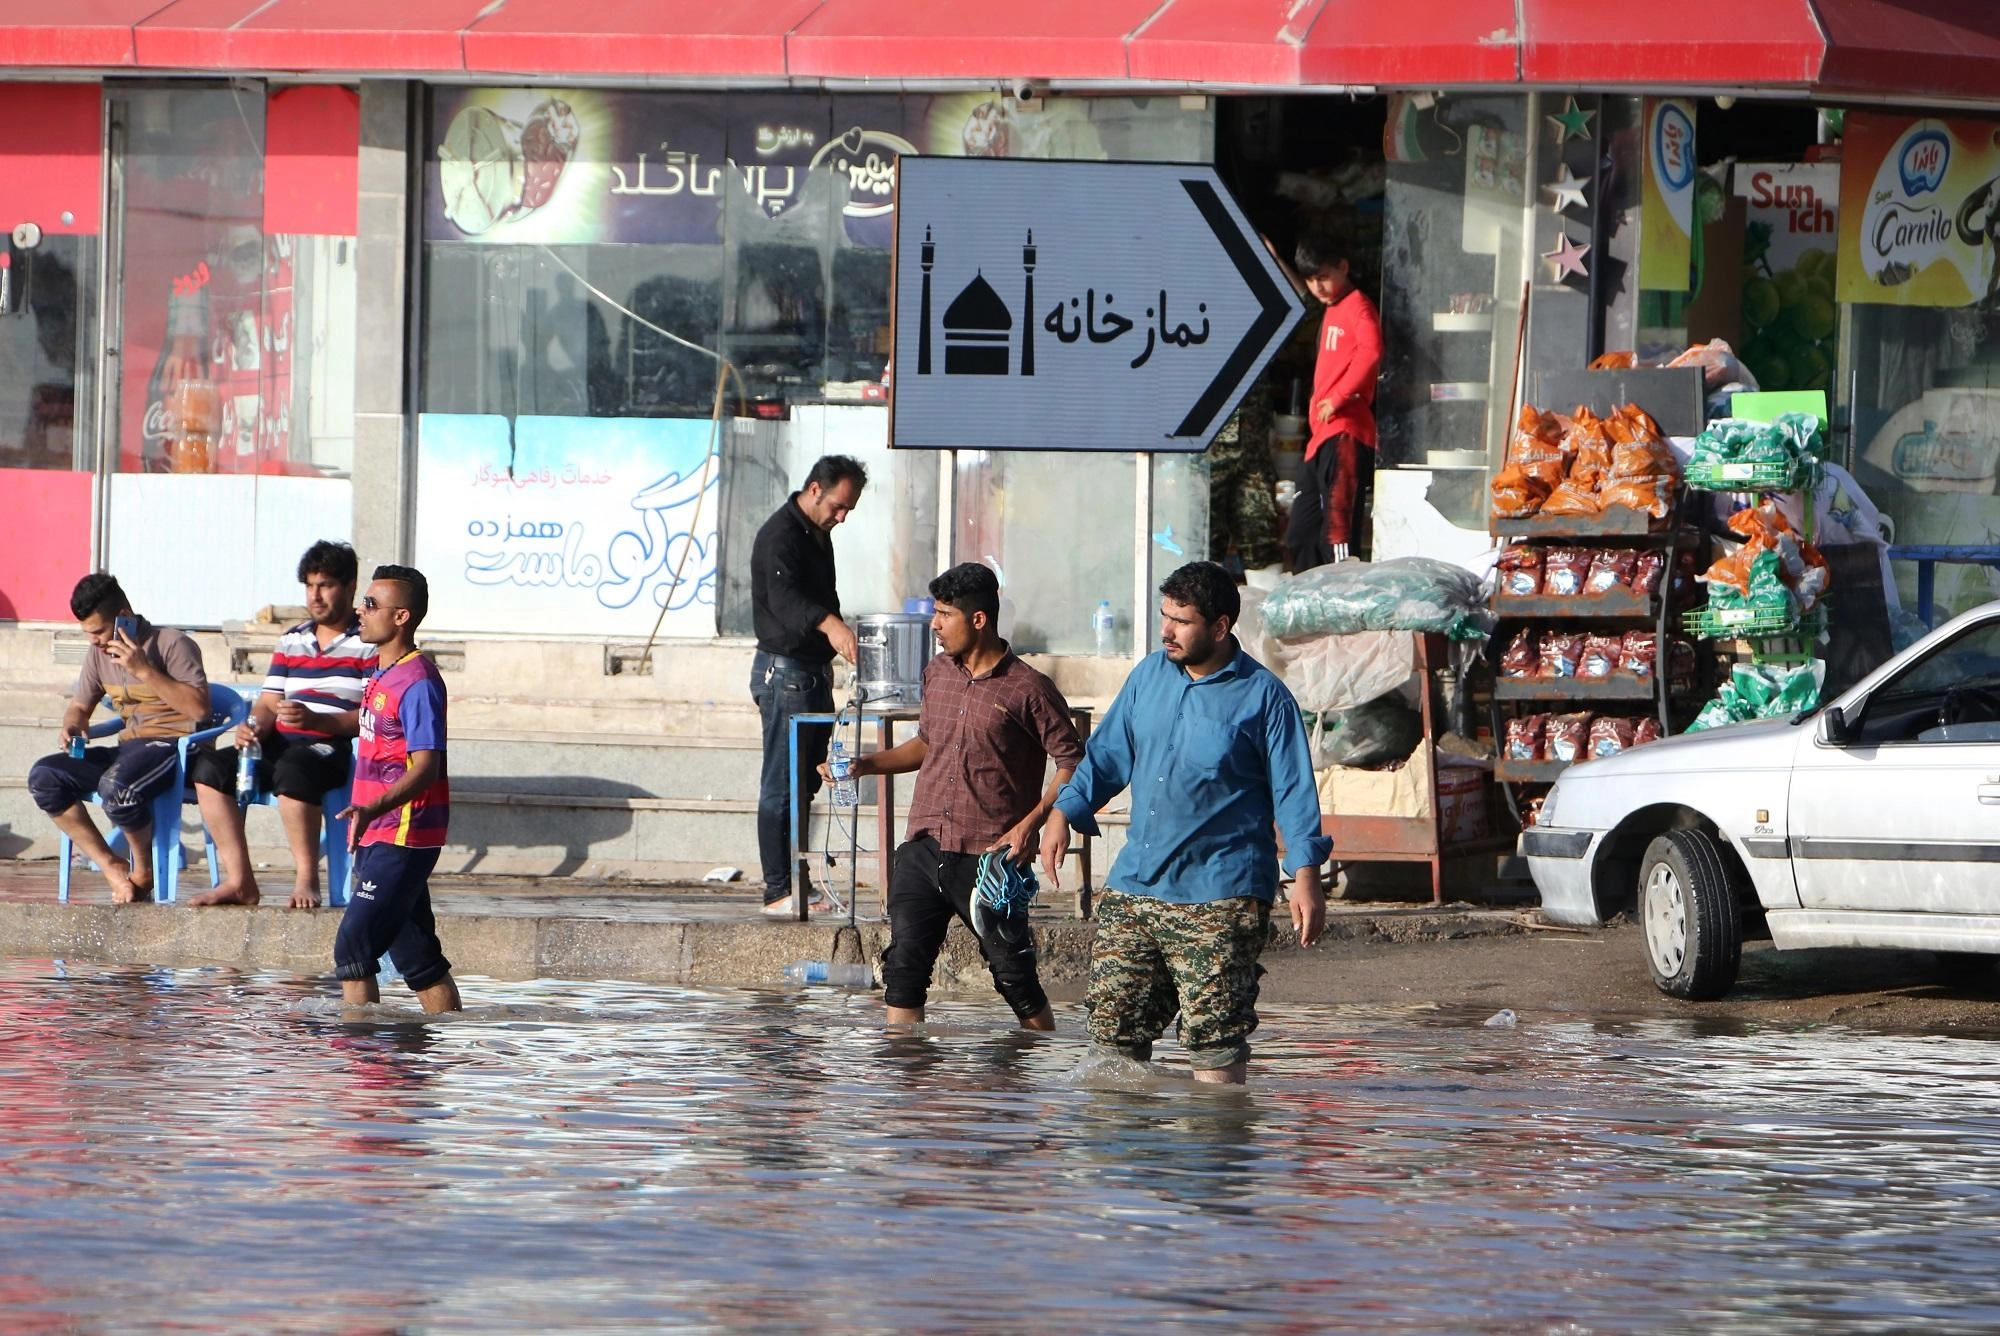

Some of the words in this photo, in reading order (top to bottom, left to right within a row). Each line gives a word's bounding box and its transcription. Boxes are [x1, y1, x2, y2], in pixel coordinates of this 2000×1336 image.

[1751, 171, 1815, 209] Sun
[1788, 197, 1834, 233] ich
[1875, 208, 1952, 256] Carnilo
[561, 464, 613, 486] خدمات
[468, 513, 564, 543] همزده
[465, 521, 602, 588] ماست
